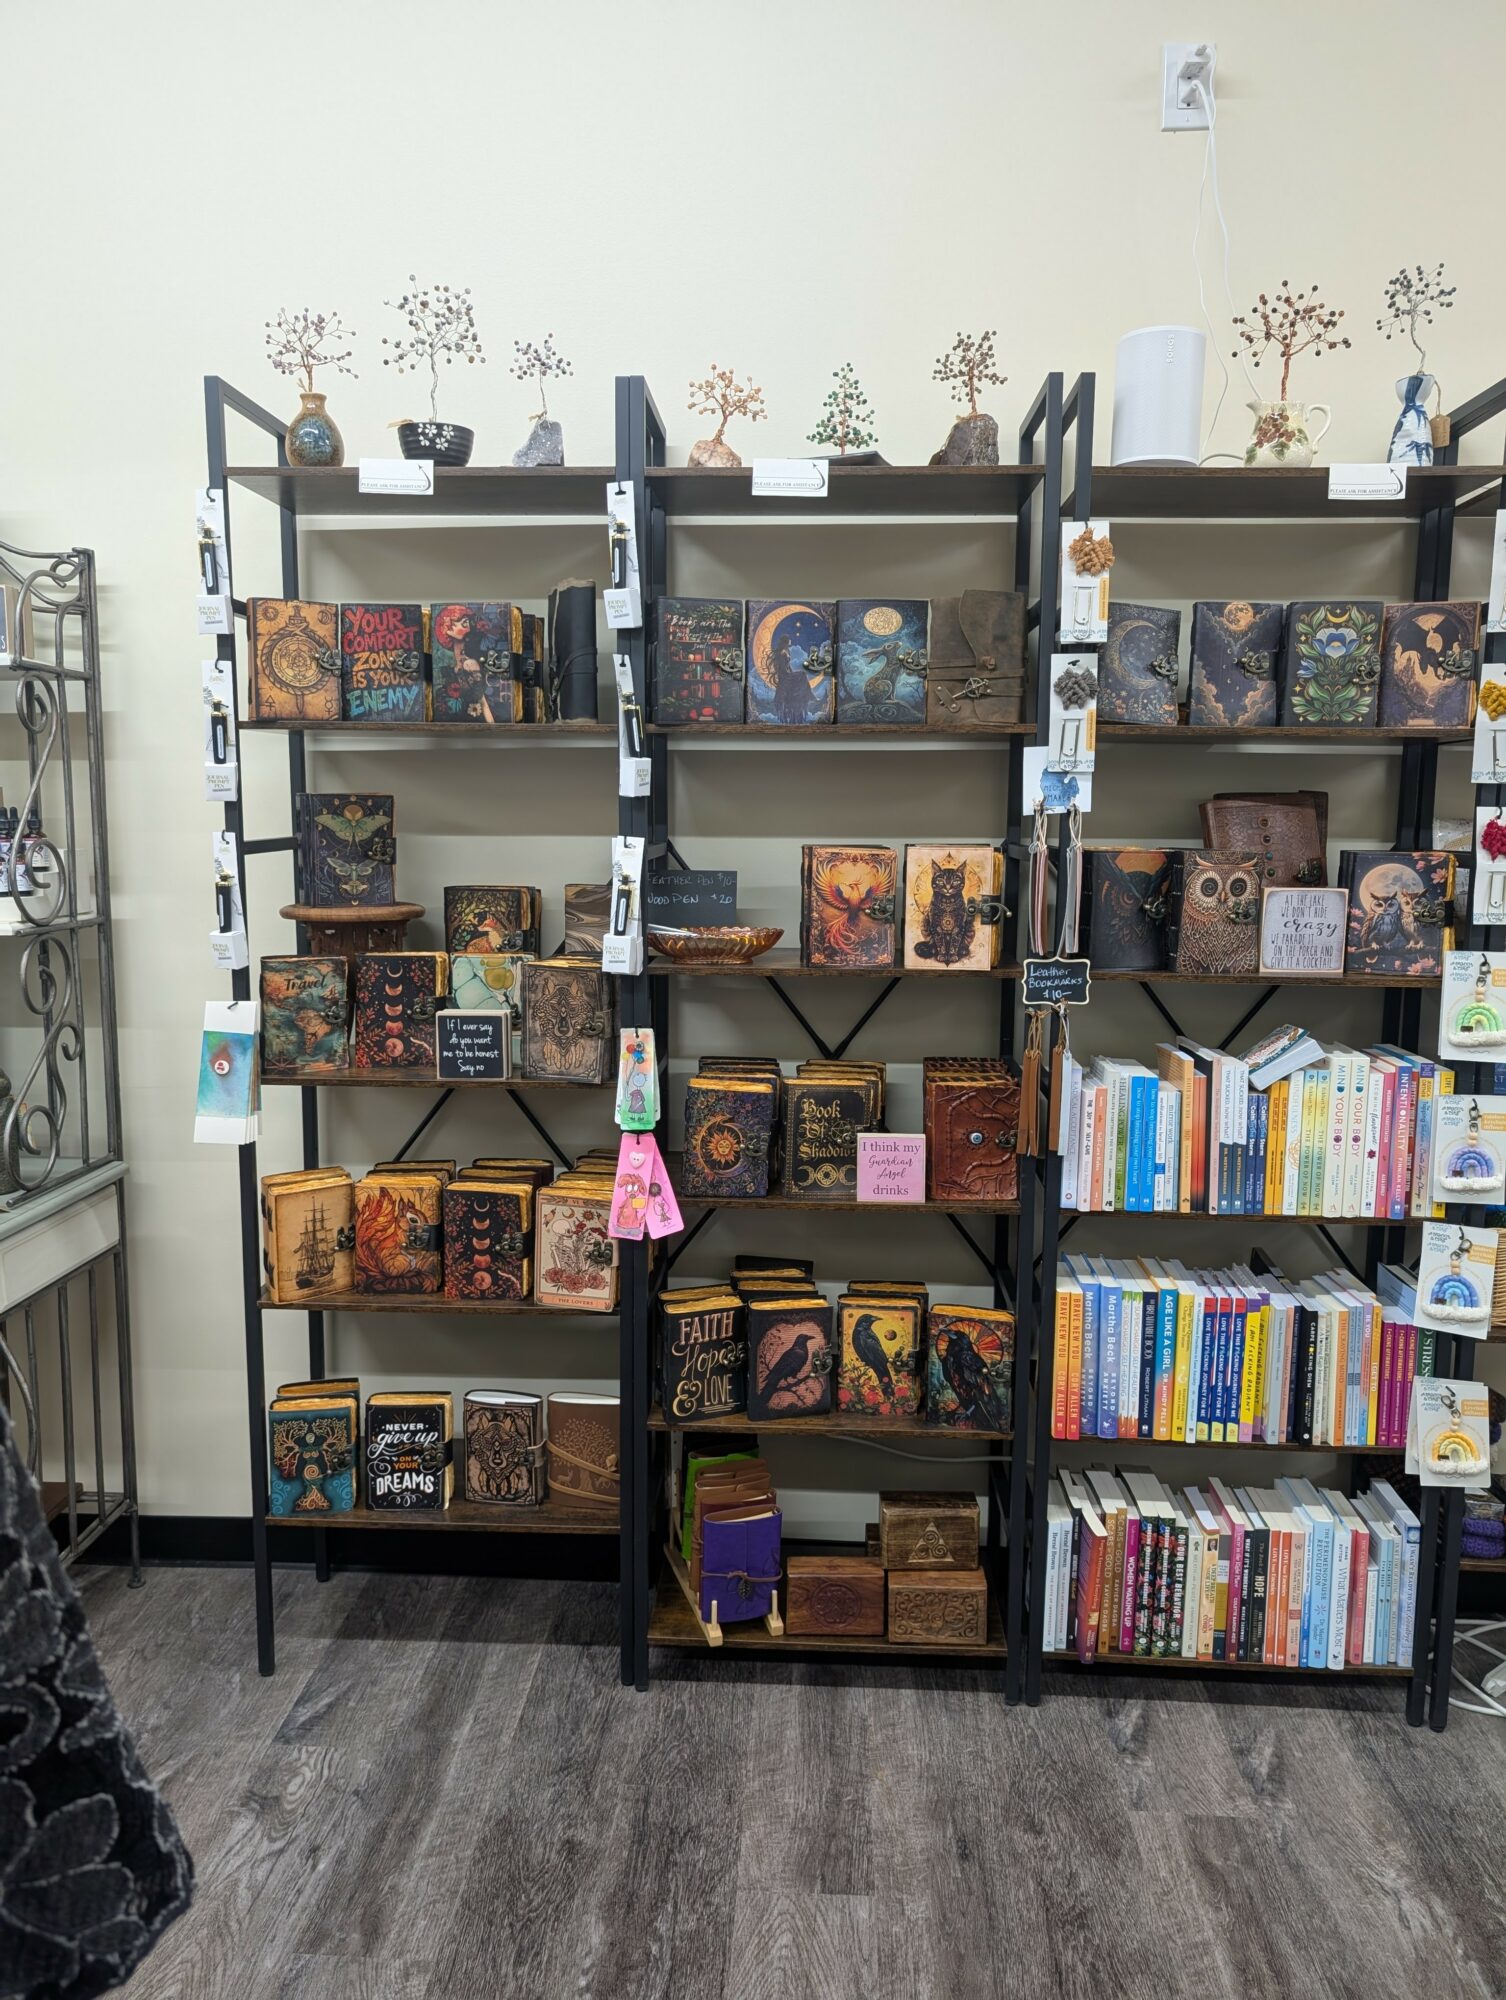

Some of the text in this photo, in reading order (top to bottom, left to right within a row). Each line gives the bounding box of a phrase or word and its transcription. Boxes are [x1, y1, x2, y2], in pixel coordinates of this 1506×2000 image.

[344, 606, 407, 636] YOUR
[342, 625, 419, 654] COMFORT
[352, 650, 402, 672] ZON
[346, 685, 419, 718] ENEMY
[672, 893, 698, 904] PEN
[1285, 895, 1325, 906] AT THE LAKE
[1292, 907, 1311, 918] DON'T
[1313, 907, 1327, 918] HIDE
[1284, 919, 1338, 937] crazy
[1271, 957, 1285, 968] GIVE
[1287, 957, 1293, 968] IT
[1303, 957, 1332, 968] COCKTAIL
[1274, 945, 1333, 957] ON THE PORCH AND
[1030, 964, 1071, 977] Leather
[284, 976, 325, 991] Travel
[1028, 977, 1082, 988] BOOKMARKS
[447, 1018, 455, 1031] If
[479, 1024, 493, 1035] say
[449, 1033, 492, 1049] do you want
[464, 1046, 474, 1057] be
[475, 1046, 499, 1058] honest
[458, 1060, 474, 1076] Say
[800, 1098, 841, 1118] Book
[1117, 1082, 1127, 1146] HEALING POWER
[1333, 1064, 1346, 1157] MIND YOUR BODY
[1351, 1064, 1365, 1157] MIND YOUR BODY
[1133, 1120, 1141, 1144] breaking
[1147, 1121, 1156, 1145] breaking
[862, 1141, 921, 1155] I think my
[868, 1155, 913, 1168] Guardian
[877, 1168, 906, 1181] Angel
[873, 1185, 909, 1196] drinks
[1060, 1296, 1068, 1320] BRAVE
[1165, 1295, 1174, 1314] AGE
[679, 1311, 735, 1345] FAITH
[1059, 1324, 1067, 1339] NEW
[1084, 1291, 1094, 1359] Martha Beck
[1106, 1295, 1117, 1363] Martha Beck
[1163, 1316, 1173, 1337] LIKE
[1058, 1343, 1066, 1358] YOU
[1070, 1299, 1080, 1418] BRAVE NEW YOU CORY ALLEN
[1120, 1304, 1131, 1396] SUPERCHARGED SELF-HEALING
[1131, 1306, 1142, 1398] SUPERCHARGED SELF-HEALING
[1143, 1340, 1153, 1360] BODY
[1162, 1348, 1171, 1370] GIRL
[1143, 1367, 1151, 1393] ROBERT
[673, 1374, 733, 1417] & LOVE
[1057, 1393, 1065, 1416] ALLEN
[386, 1423, 424, 1431] NEVER
[368, 1431, 439, 1458] give up
[393, 1462, 419, 1470] YOUR
[376, 1472, 434, 1495] DREAMS
[1107, 1520, 1115, 1546] SCARS
[1116, 1515, 1125, 1541] SCARS
[1105, 1555, 1113, 1578] GOLD
[1114, 1550, 1122, 1573] GOLD
[1315, 1540, 1323, 1586] REVOLUTION
[1320, 1541, 1329, 1600] PERIMENOPAUSE
[1173, 1535, 1186, 1618] ON OUR BEST BEHAVIOR
[1124, 1556, 1135, 1627] WOMEN WAKING UP
[1334, 1567, 1347, 1648] What Matters Most
